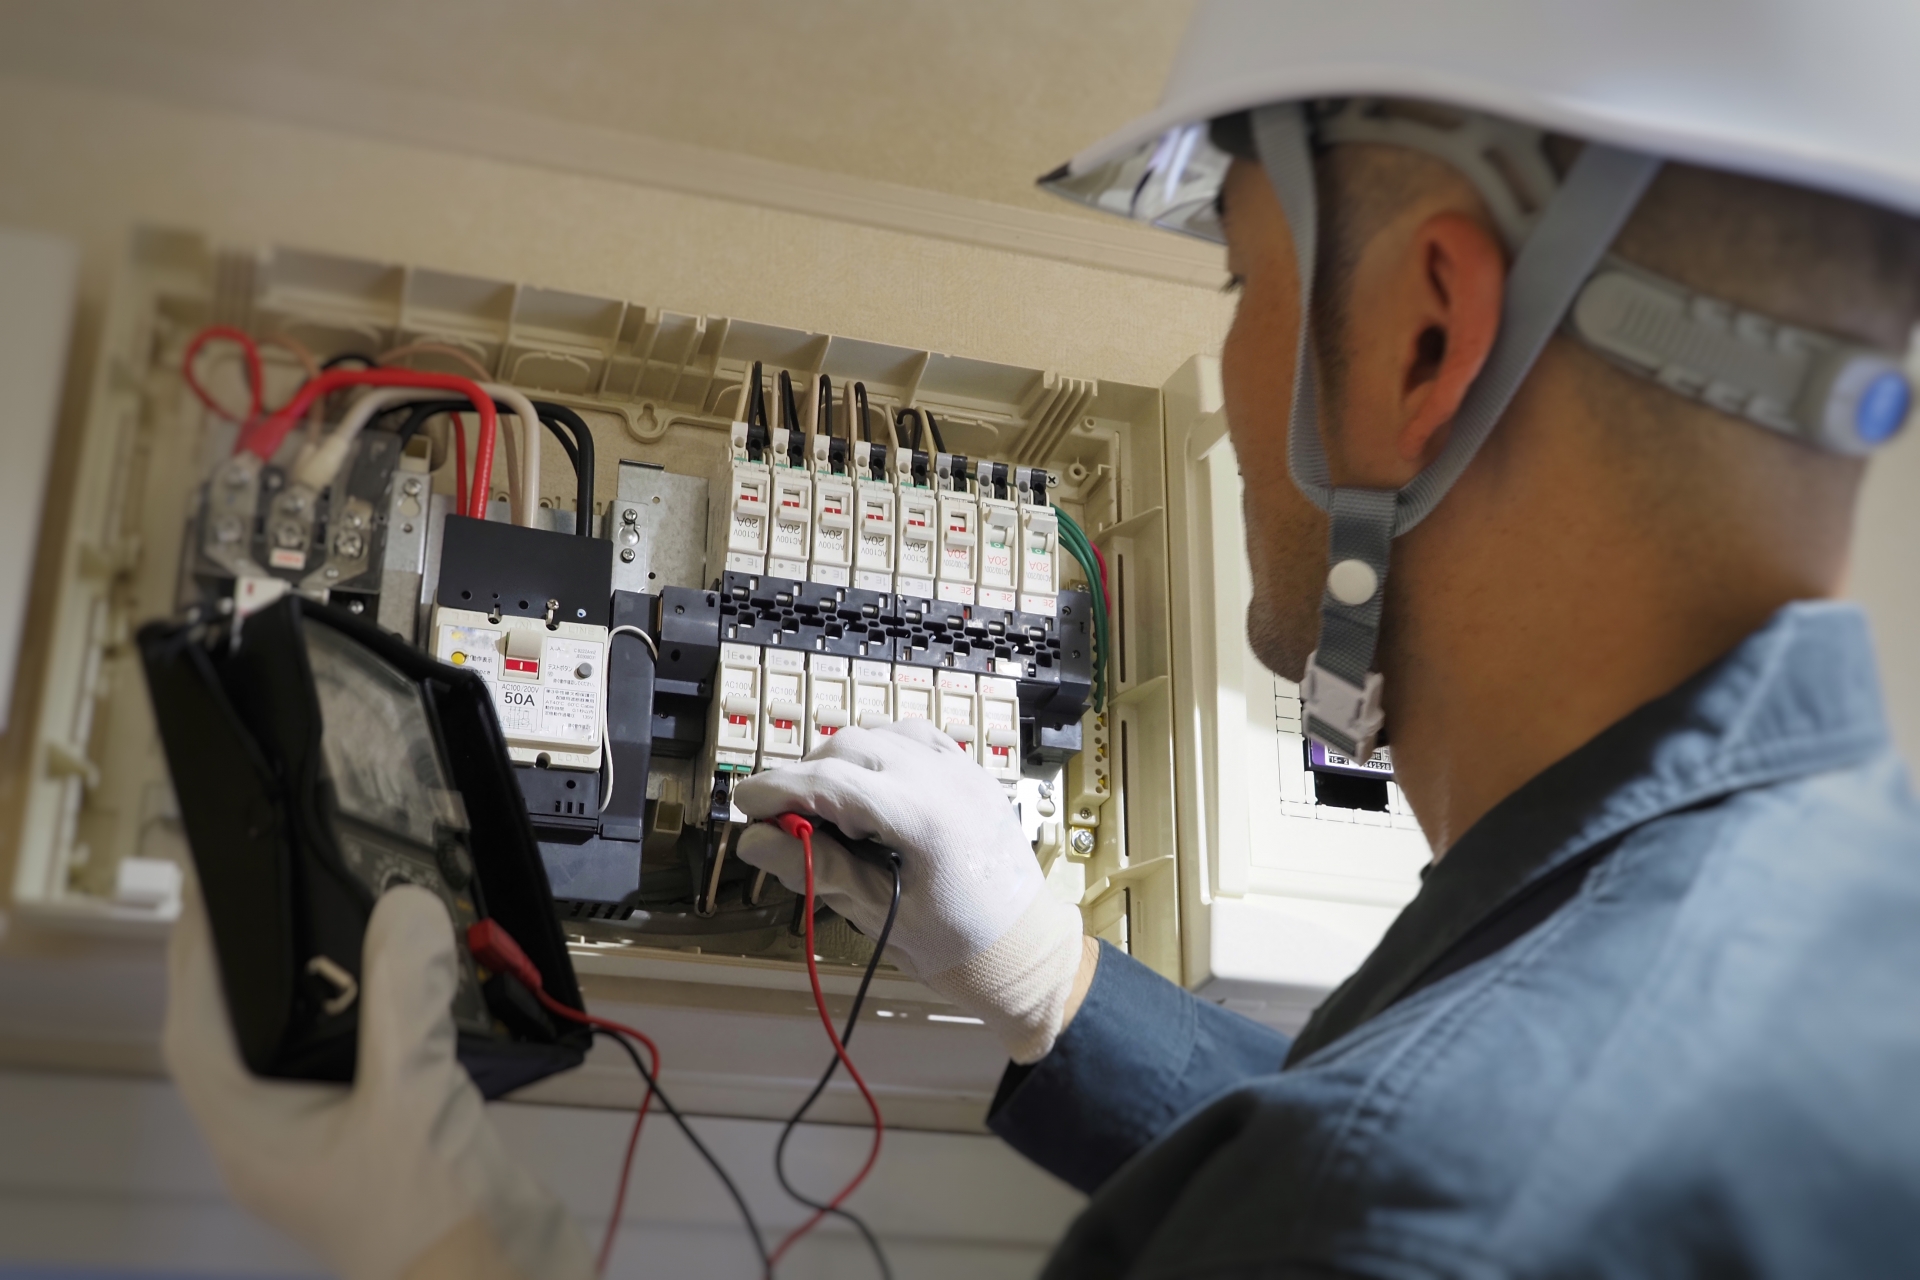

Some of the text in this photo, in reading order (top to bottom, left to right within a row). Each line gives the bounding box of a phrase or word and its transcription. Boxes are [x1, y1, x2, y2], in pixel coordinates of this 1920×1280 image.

[736, 516, 759, 529] 20A
[778, 522, 801, 535] 20A
[820, 528, 843, 541] 20A
[863, 535, 885, 547] 20A
[905, 541, 927, 553] 20A
[946, 548, 968, 560] 20A
[987, 555, 1008, 567] 20A
[1028, 561, 1049, 572] 20A
[501, 684, 539, 694] AC100/200V
[504, 692, 535, 707] 50A
